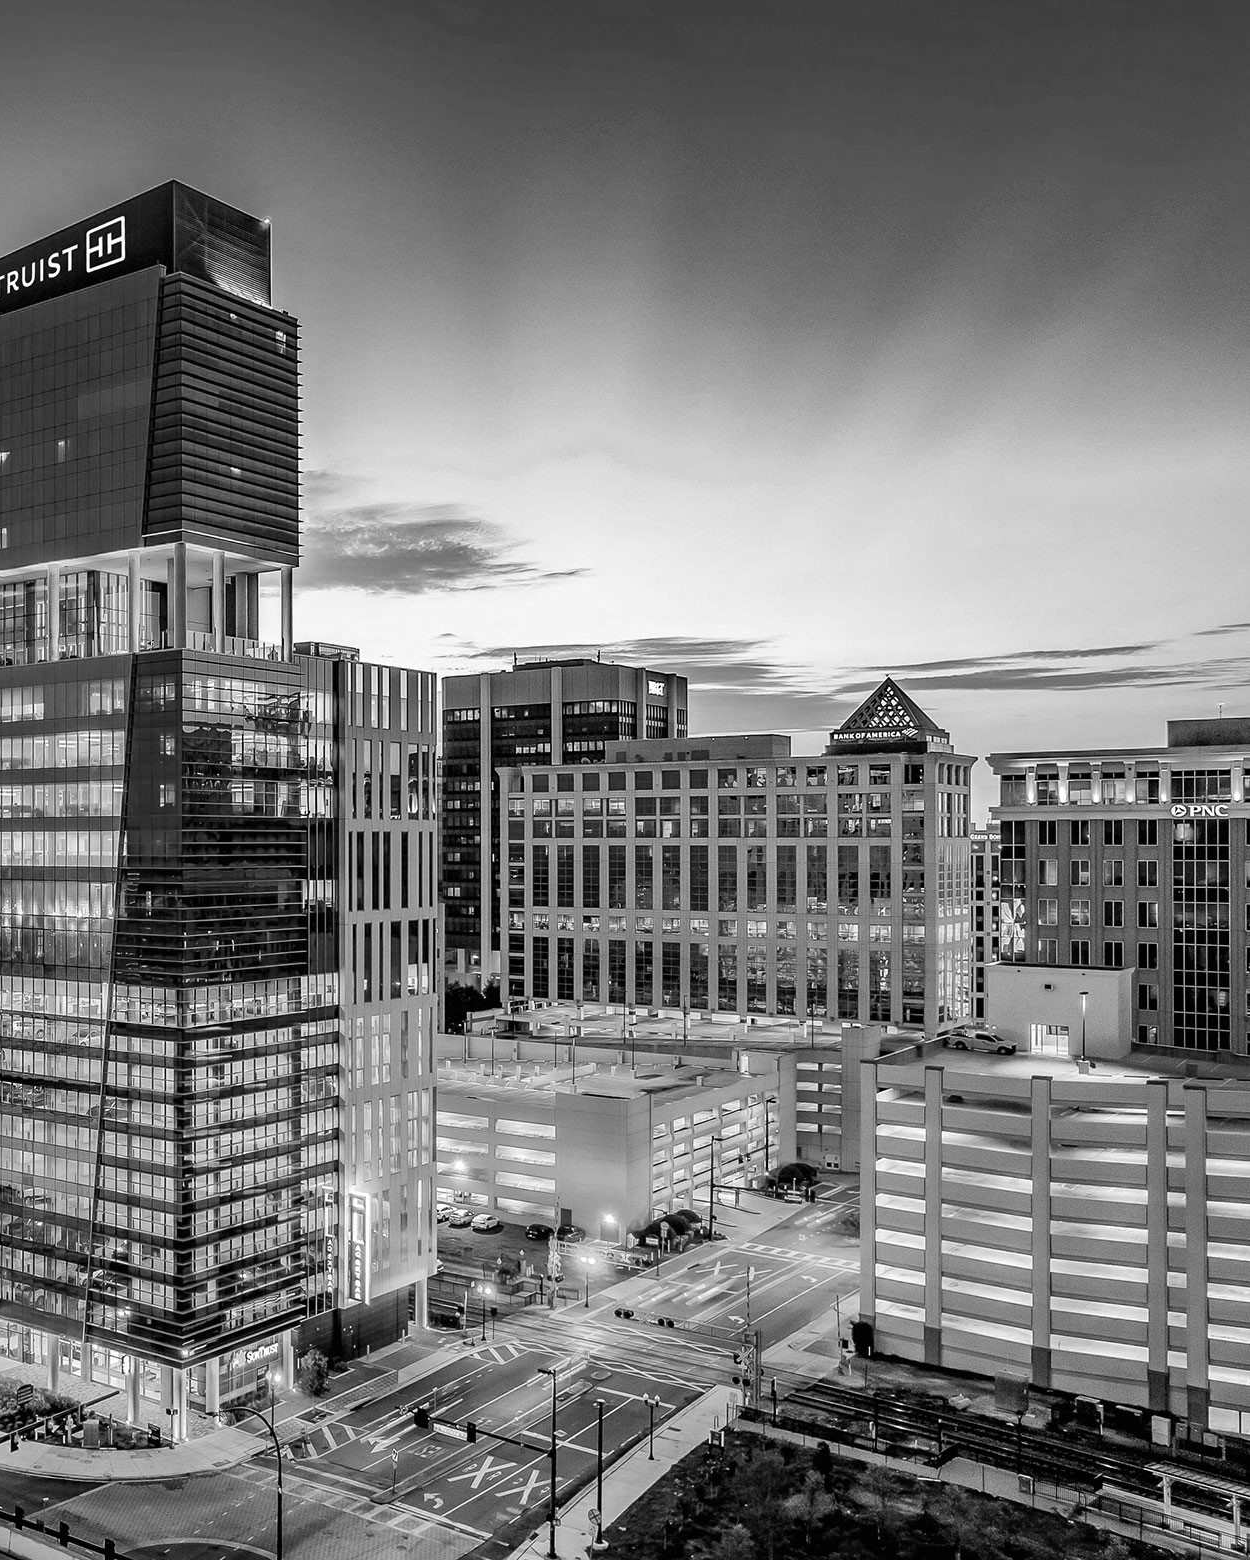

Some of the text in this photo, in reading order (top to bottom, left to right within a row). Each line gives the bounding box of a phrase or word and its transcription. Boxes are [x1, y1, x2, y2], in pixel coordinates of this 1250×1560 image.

[833, 732, 855, 740] BANK
[866, 731, 901, 739] AMERICA
[1188, 804, 1229, 817] PNC
